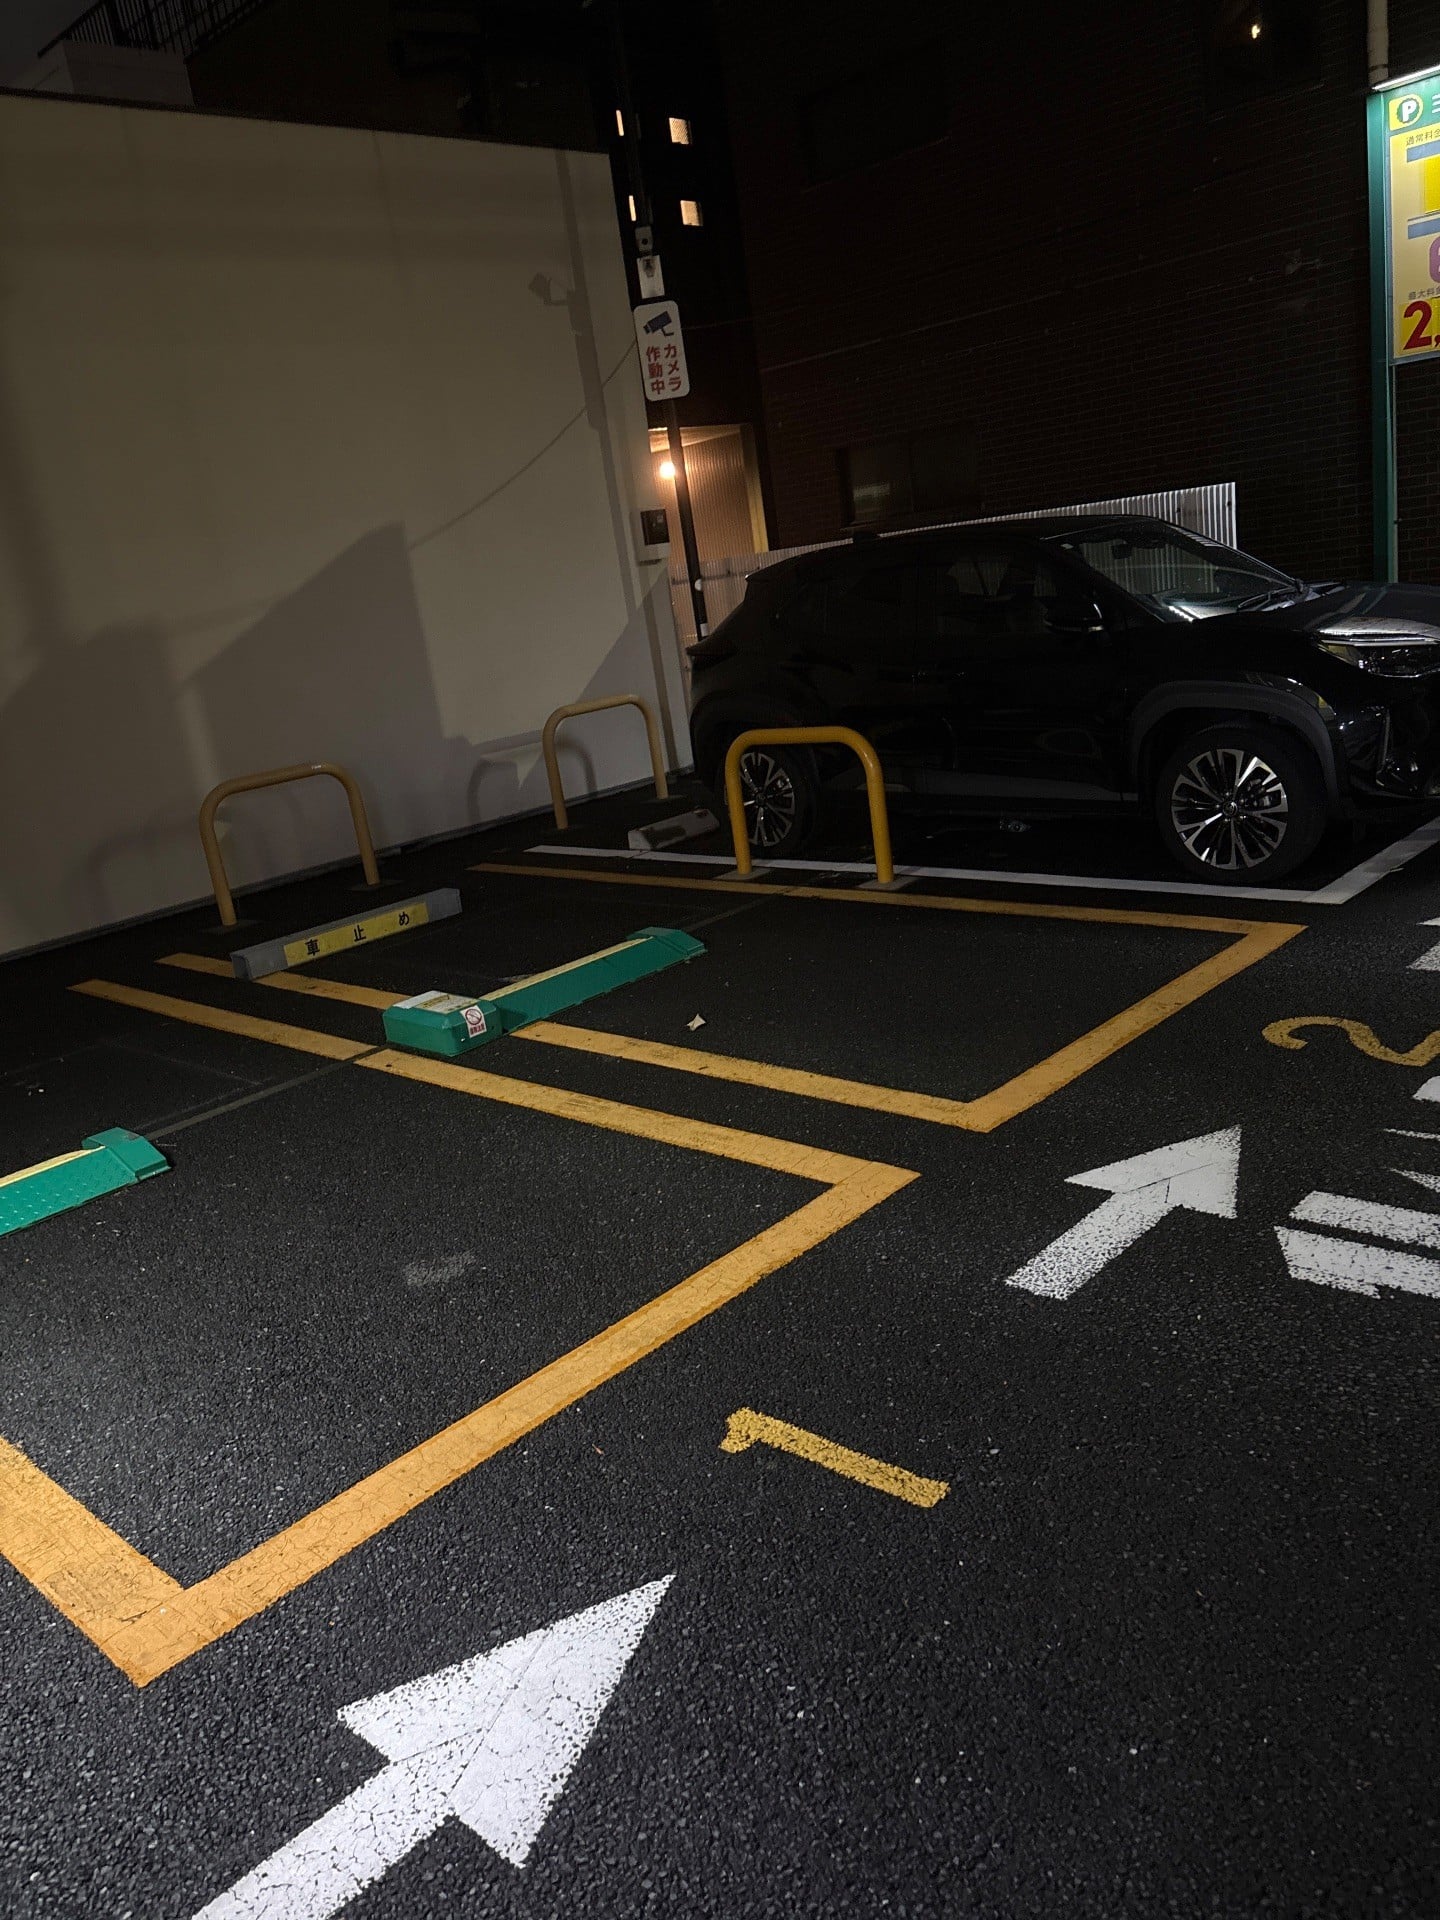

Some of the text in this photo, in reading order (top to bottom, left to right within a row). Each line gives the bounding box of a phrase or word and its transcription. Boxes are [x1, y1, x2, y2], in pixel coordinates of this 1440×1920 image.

[645, 345, 666, 395] 作動中
[664, 343, 682, 392] カメラ
[304, 911, 410, 956] 車止め
[718, 1406, 951, 1509] 1
